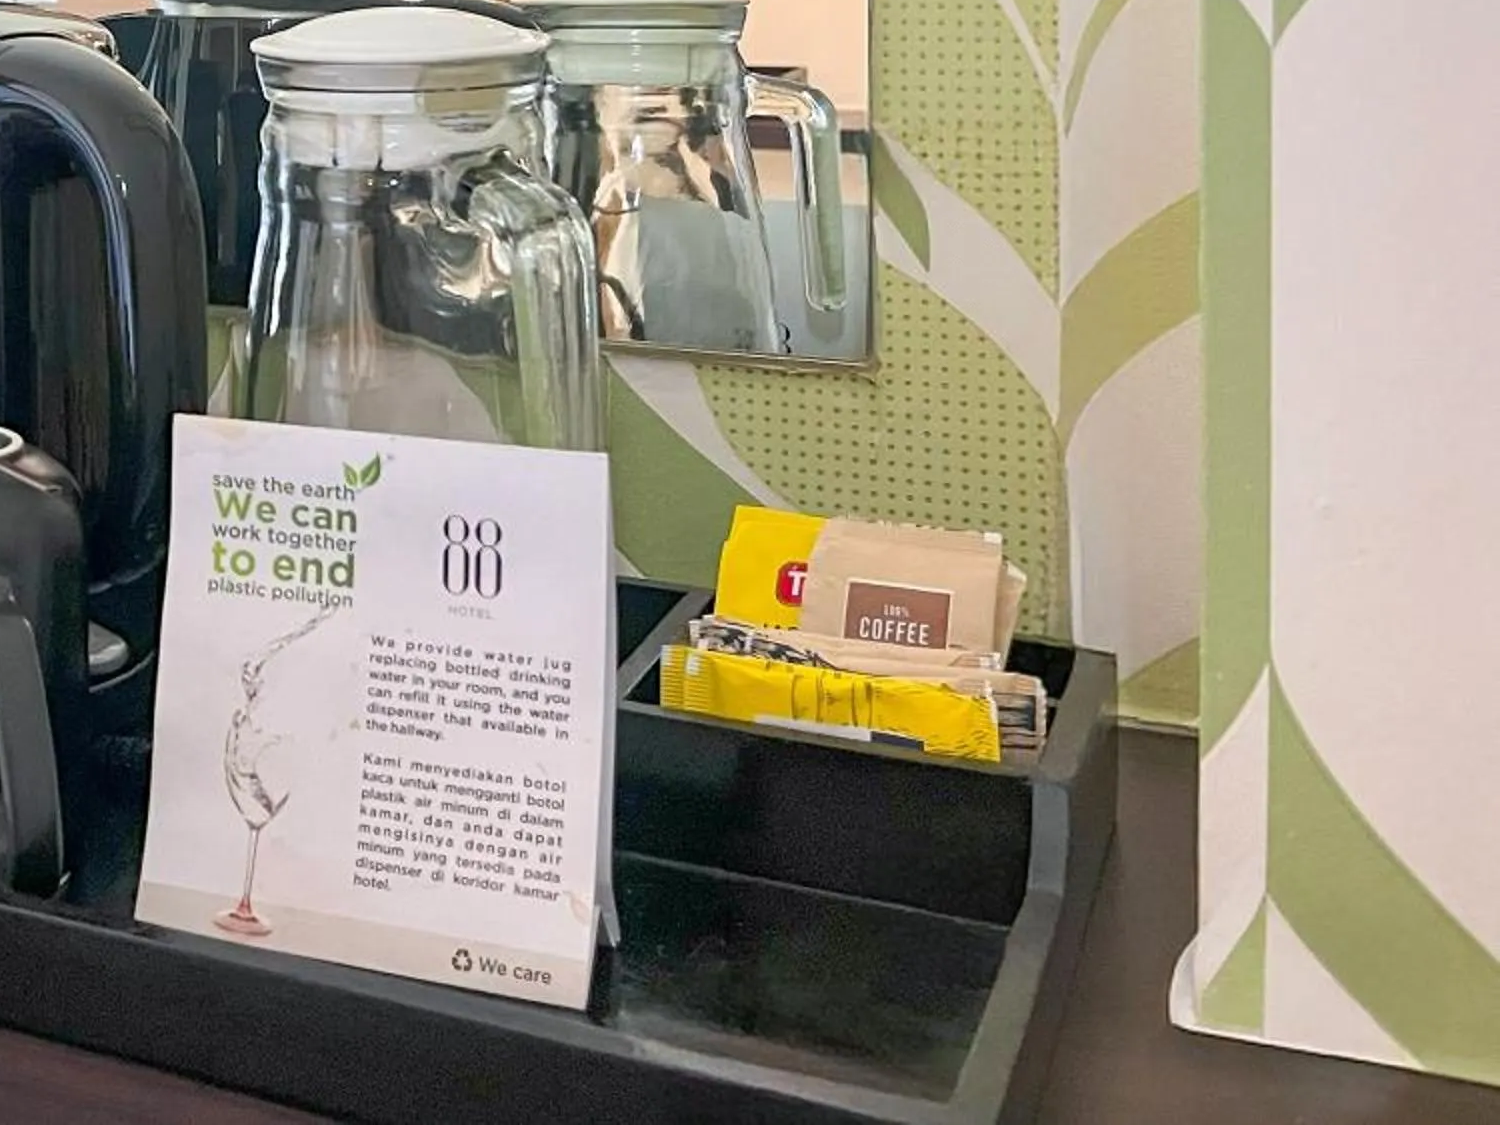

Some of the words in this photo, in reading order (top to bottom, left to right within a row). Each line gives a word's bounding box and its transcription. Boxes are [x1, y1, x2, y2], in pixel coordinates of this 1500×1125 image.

[212, 474, 256, 490] save
[263, 477, 295, 495] the
[301, 483, 356, 502] earth
[214, 488, 277, 523] We
[291, 504, 357, 533] can
[212, 523, 261, 542] work
[268, 527, 357, 552] together
[443, 514, 503, 599] 88
[212, 541, 257, 576] to
[272, 554, 355, 588] end
[207, 577, 266, 598] plastic
[271, 586, 353, 608] pollution
[448, 606, 495, 620] HOTEL
[858, 616, 931, 646] COFFEE
[369, 652, 437, 672] replacing
[445, 661, 500, 678] bottled
[509, 671, 571, 690] drinking
[371, 635, 395, 648] We
[405, 640, 473, 658] provide
[484, 651, 533, 666] water
[544, 656, 572, 673] jug
[367, 686, 393, 698] can
[399, 689, 430, 704] refill
[437, 694, 446, 706] it
[453, 697, 491, 713] using
[499, 703, 522, 716] the
[529, 707, 570, 722] water
[369, 670, 407, 683] water
[412, 674, 425, 686] in
[429, 678, 460, 692] your
[465, 681, 507, 699] room,
[512, 688, 539, 702] and
[544, 692, 571, 707] you
[365, 718, 388, 732] the
[390, 722, 446, 742] hallway.
[366, 702, 436, 722] dispenser
[443, 711, 473, 727] that
[481, 719, 547, 737] available
[555, 726, 570, 740] in
[362, 769, 393, 785] kaca
[399, 776, 438, 792] untuk
[444, 782, 521, 804] mengganti
[527, 794, 566, 811] botol
[363, 752, 402, 769] Kami
[410, 760, 514, 785] menyediakan
[523, 775, 567, 793] botol
[360, 804, 413, 825] kamar,
[423, 815, 453, 829] dan
[463, 821, 503, 838] anda
[513, 828, 563, 848] dapat
[361, 788, 406, 805] plastik
[415, 796, 432, 808] air
[441, 799, 489, 817] minum
[497, 808, 512, 821] di
[519, 811, 564, 829] dalam
[357, 840, 405, 857] minum
[413, 849, 447, 866] yang
[455, 856, 515, 876] tersedia
[523, 868, 561, 884] pada
[358, 823, 454, 848] mengisinya
[464, 839, 529, 859] dengan
[539, 851, 563, 866] air
[353, 875, 392, 891] hotel.
[355, 857, 422, 878] dispenser
[431, 869, 445, 882] di
[453, 873, 505, 892] koridor
[513, 883, 560, 901] kamar
[479, 955, 507, 976] We
[513, 966, 552, 985] care
